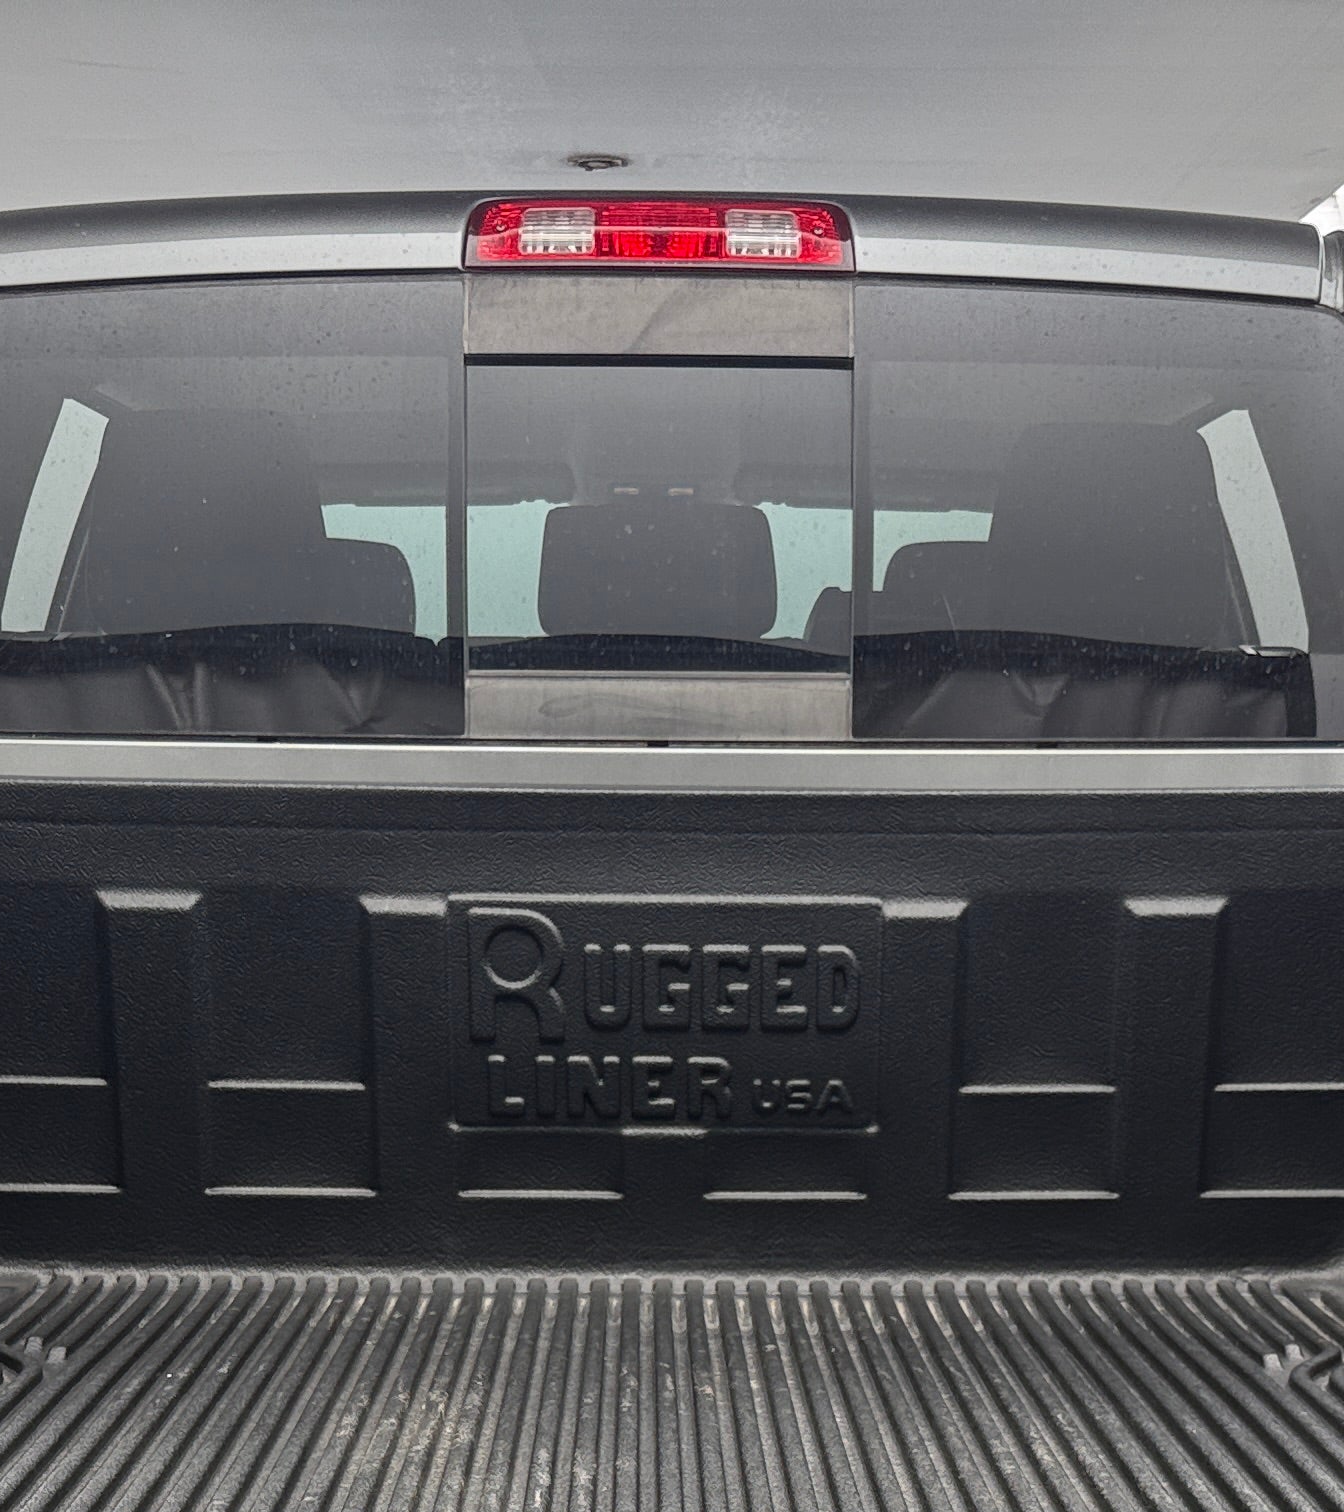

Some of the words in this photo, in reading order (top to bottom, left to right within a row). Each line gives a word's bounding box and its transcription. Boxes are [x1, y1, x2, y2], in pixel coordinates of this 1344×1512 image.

[468, 906, 859, 1044] RUGGED
[487, 1054, 732, 1119] LINER
[753, 1078, 853, 1115] USA
